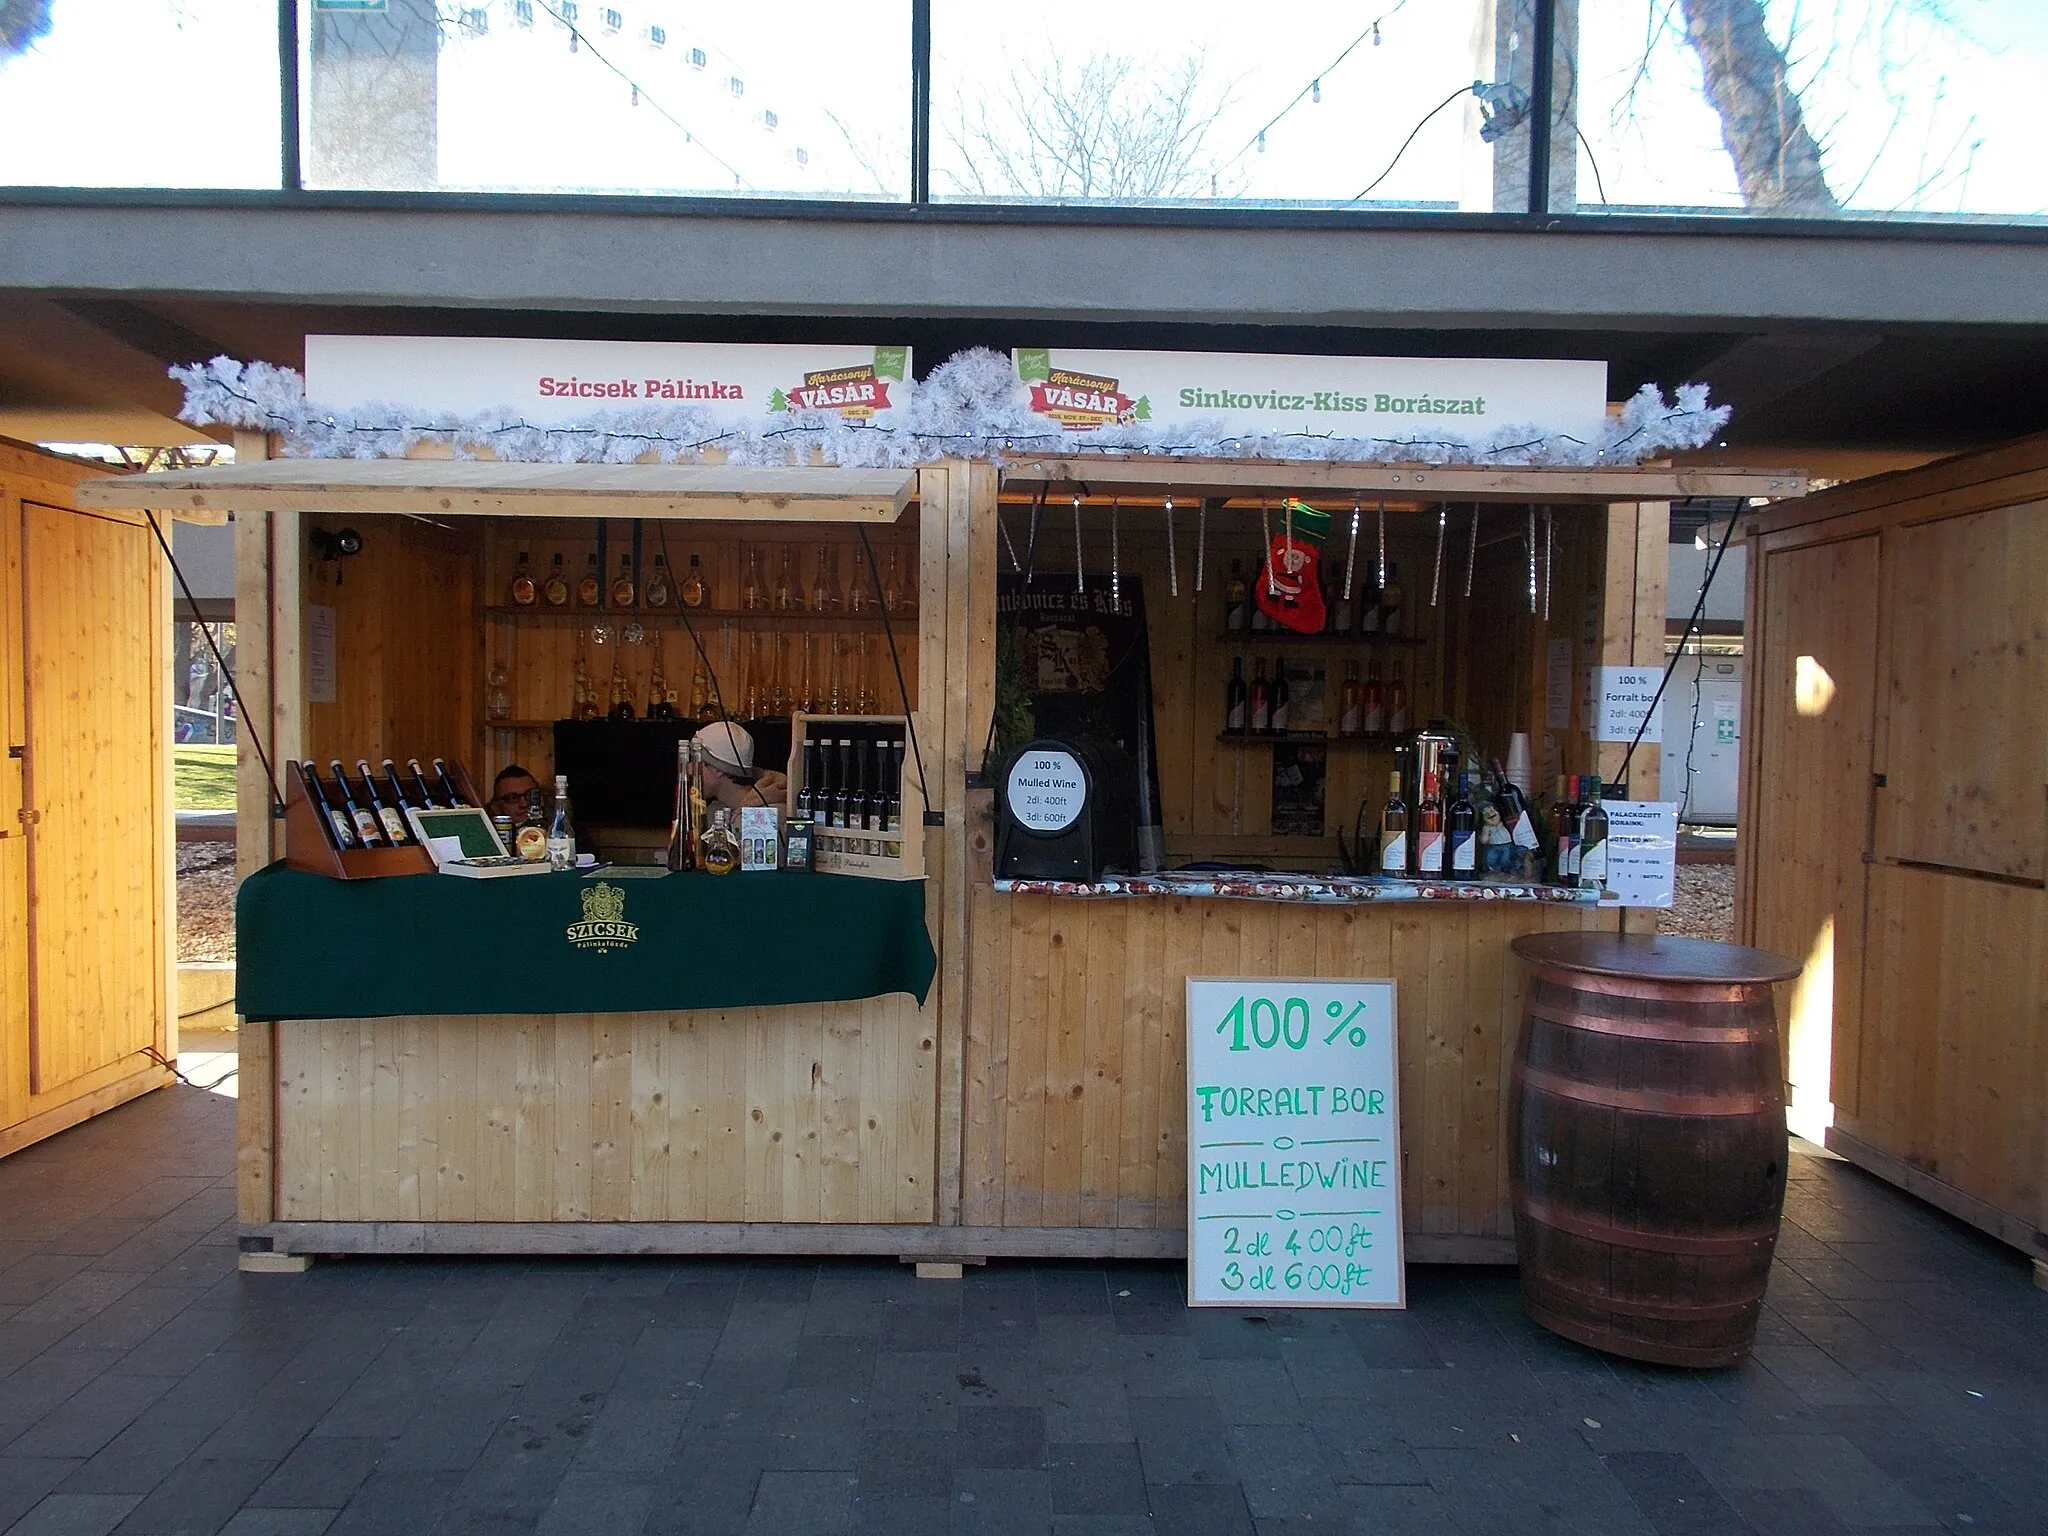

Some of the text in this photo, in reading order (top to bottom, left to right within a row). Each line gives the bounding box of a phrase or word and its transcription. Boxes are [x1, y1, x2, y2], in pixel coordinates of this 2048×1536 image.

[808, 367, 872, 387] Karácsonyi
[1050, 372, 1115, 393] Karácsonyi
[539, 377, 744, 400] Szicsek Pálinka
[800, 382, 875, 408] VÁSÁR
[1044, 386, 1118, 413] VÁSÁR
[1179, 388, 1486, 415] Sinkovicz-Kiss Borászat
[1618, 676, 1647, 685] 100 %
[1606, 693, 1657, 702] Forralt bo
[1609, 709, 1626, 718] 2dl:
[1609, 725, 1652, 735] 3dl: 60ft
[1034, 761, 1061, 770] 100 %
[1018, 778, 1077, 789] Mulled Wine
[1026, 796, 1067, 806] 2dl: 400ft
[1026, 812, 1067, 822] 3dl: 600ft
[566, 923, 640, 940] SZICSEK
[1216, 996, 1367, 1051] 100 %
[1196, 1086, 1385, 1122] FORRALT BOR
[1284, 1262, 1373, 1296] 600ft
